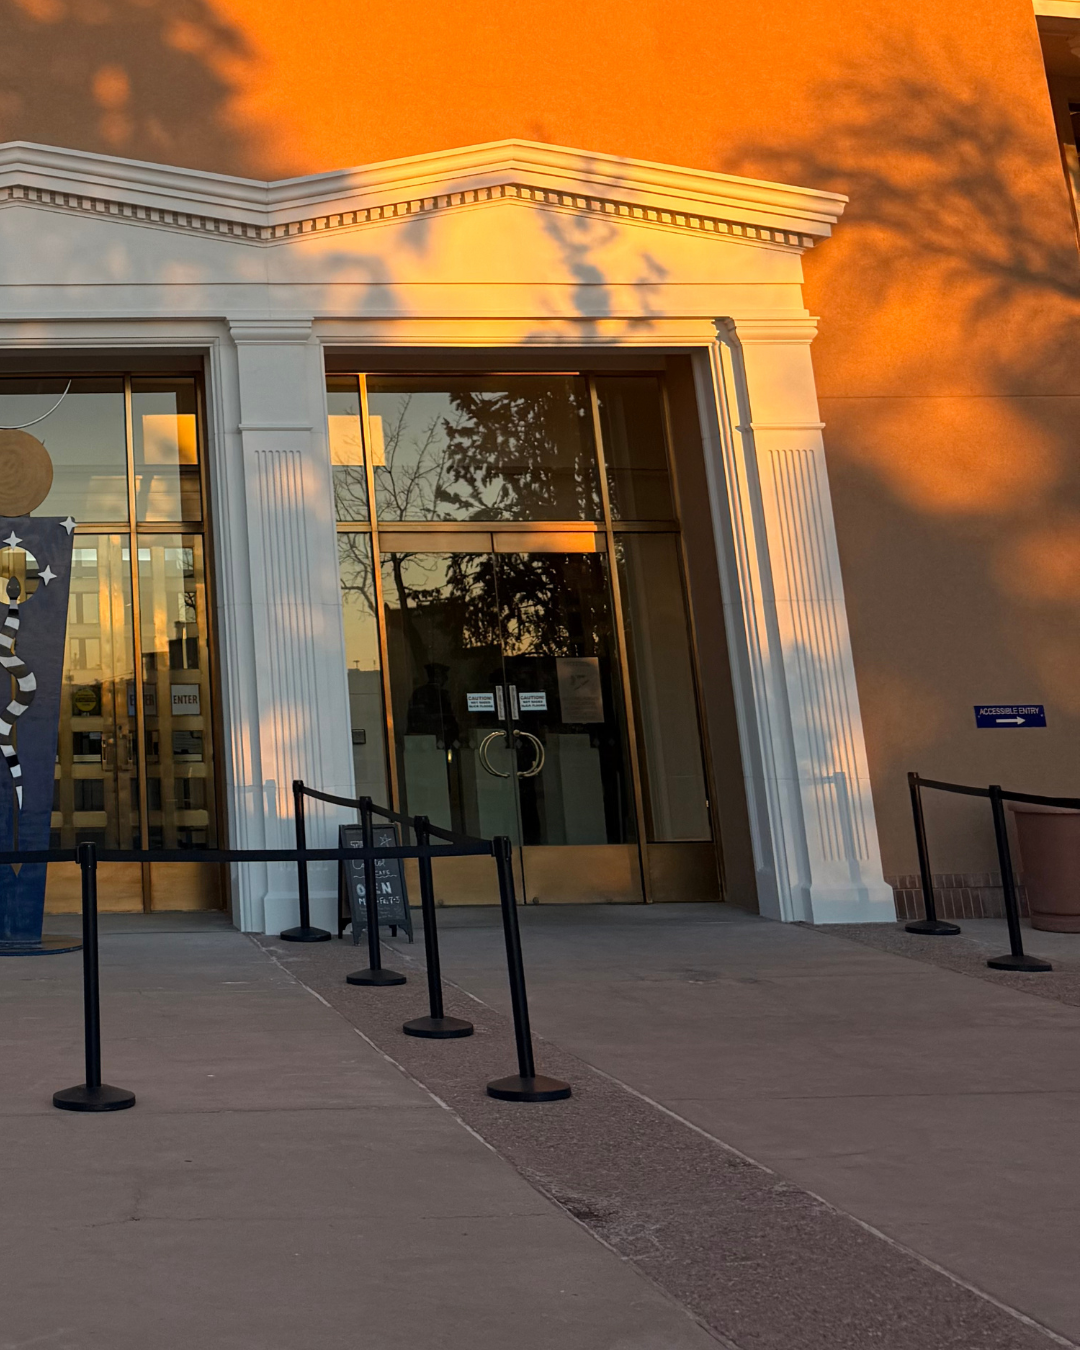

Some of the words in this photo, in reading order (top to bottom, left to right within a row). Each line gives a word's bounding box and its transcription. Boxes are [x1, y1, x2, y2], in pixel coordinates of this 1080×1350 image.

[173, 694, 198, 705] ENTER
[980, 707, 1018, 715] ACCESSIBLE
[1018, 707, 1039, 715] ENTRY
